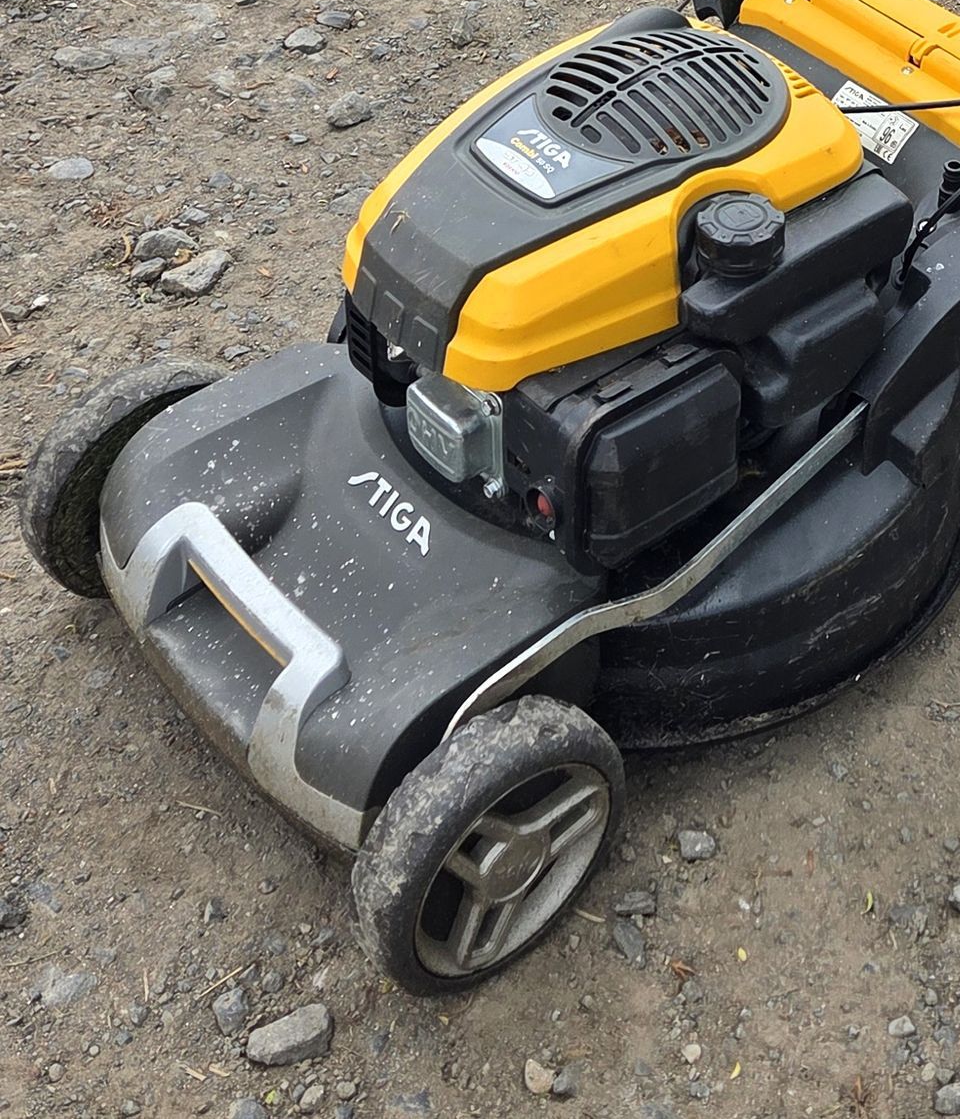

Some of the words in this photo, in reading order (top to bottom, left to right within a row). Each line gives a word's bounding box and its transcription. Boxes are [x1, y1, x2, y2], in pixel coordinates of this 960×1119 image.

[844, 86, 864, 101] STIGA
[879, 126, 896, 144] 96
[510, 137, 540, 159] Combi
[516, 128, 572, 169] STIGA
[347, 471, 431, 557] STIGA
